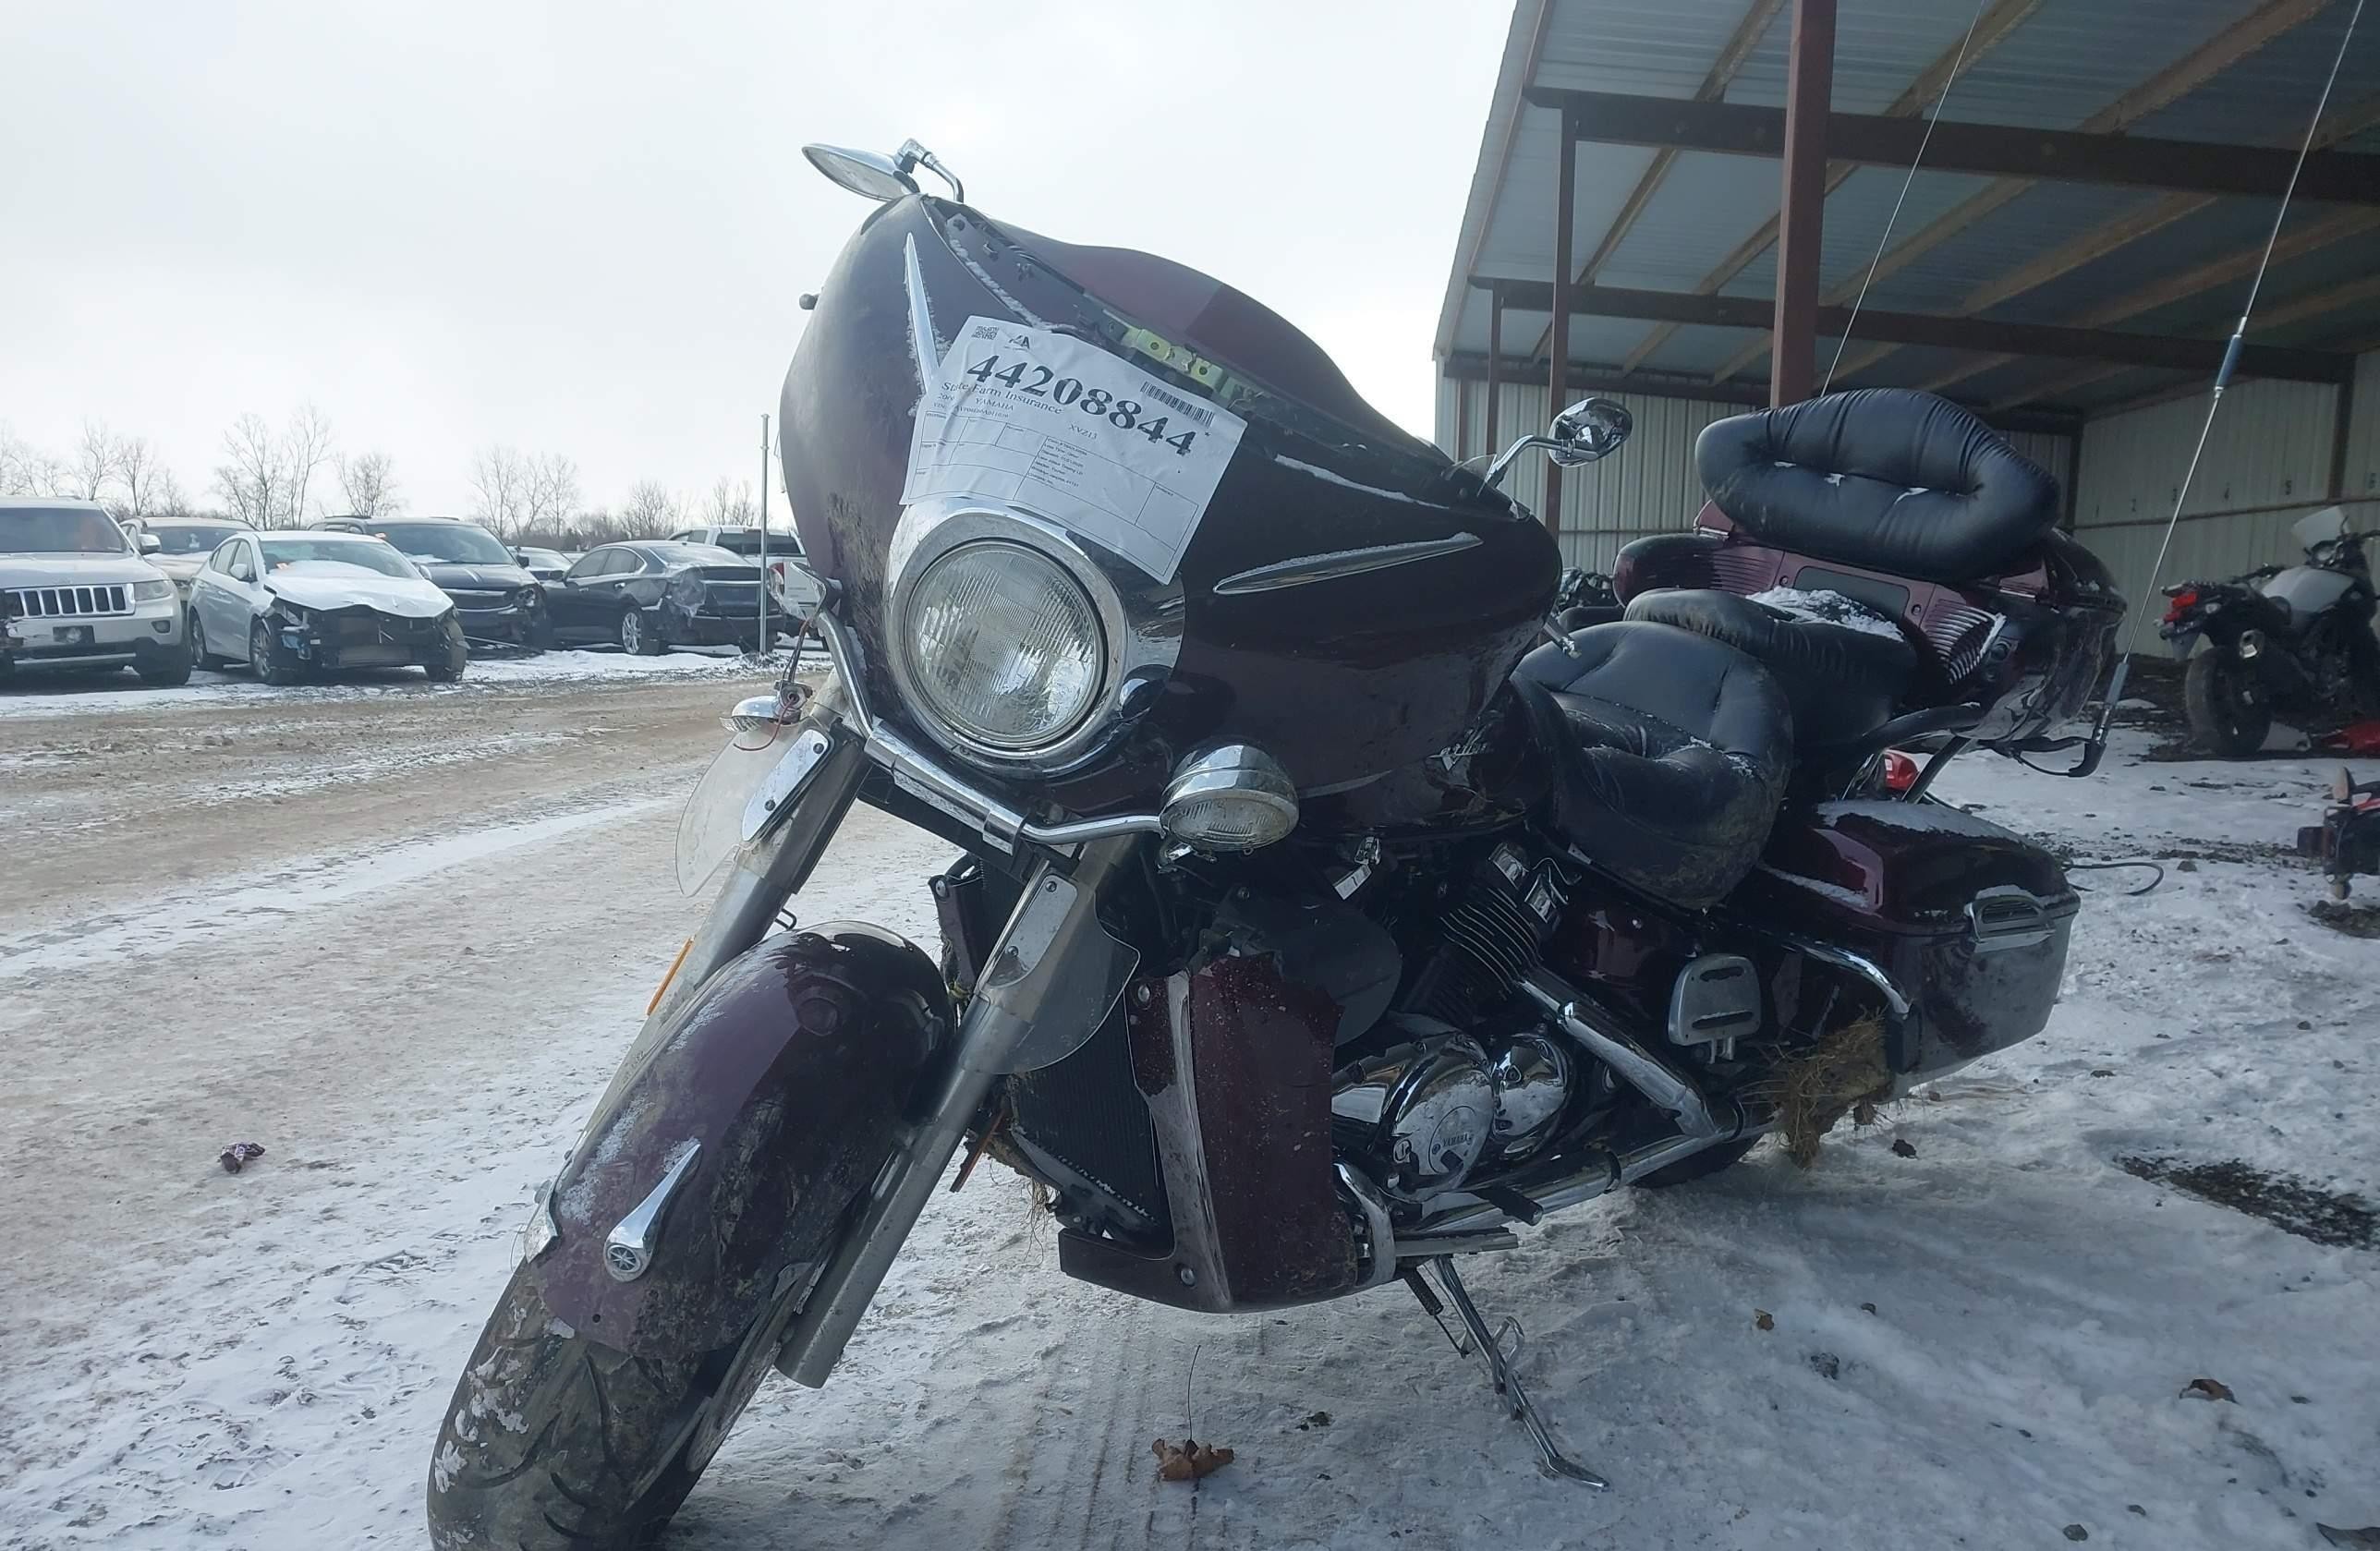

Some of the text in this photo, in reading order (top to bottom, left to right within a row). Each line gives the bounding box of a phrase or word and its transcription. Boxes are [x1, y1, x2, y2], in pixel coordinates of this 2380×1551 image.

[941, 382, 969, 392] State
[971, 383, 1002, 397] Farm
[1005, 390, 1062, 415] Insurance
[967, 355, 1197, 457] 44208844
[1068, 423, 1098, 440] XVZ13
